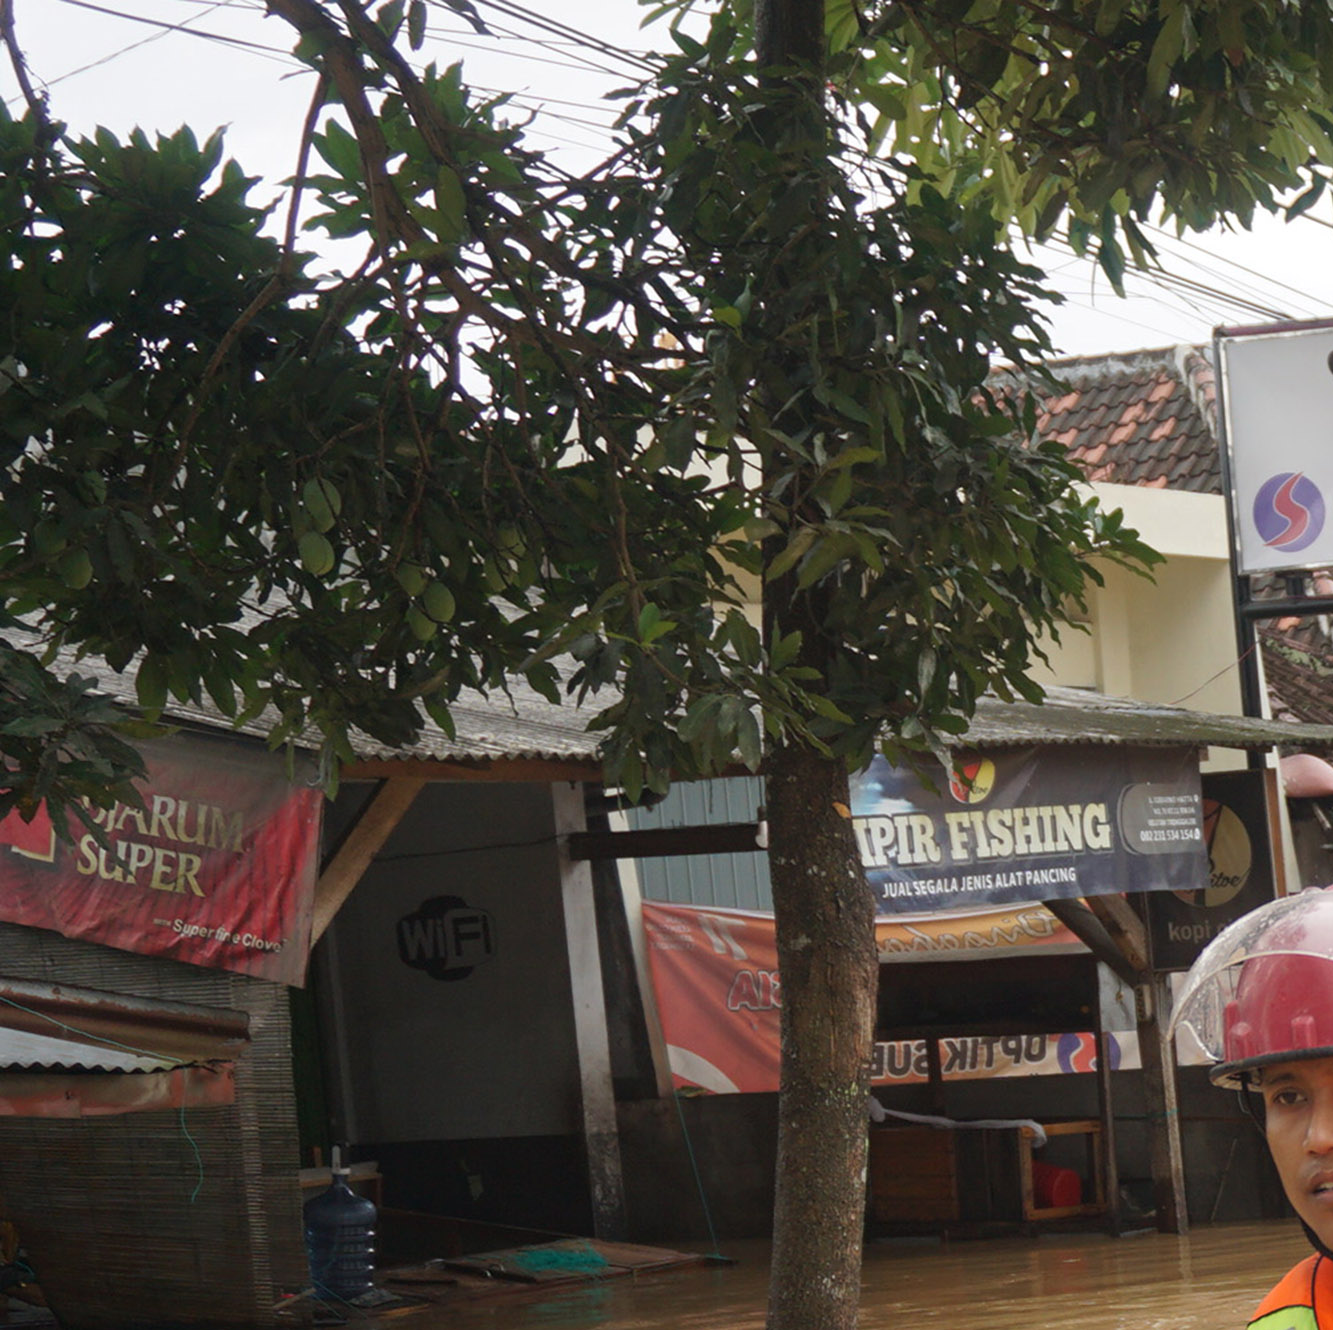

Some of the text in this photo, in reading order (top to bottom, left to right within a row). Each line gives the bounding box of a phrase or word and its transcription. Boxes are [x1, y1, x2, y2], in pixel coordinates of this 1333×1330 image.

[945, 803, 1112, 861] FISHING
[76, 834, 206, 898] SUPER
[882, 867, 1077, 899] JUAL SEGALA JENIS ALAT PANCING
[1167, 920, 1211, 944] kopi
